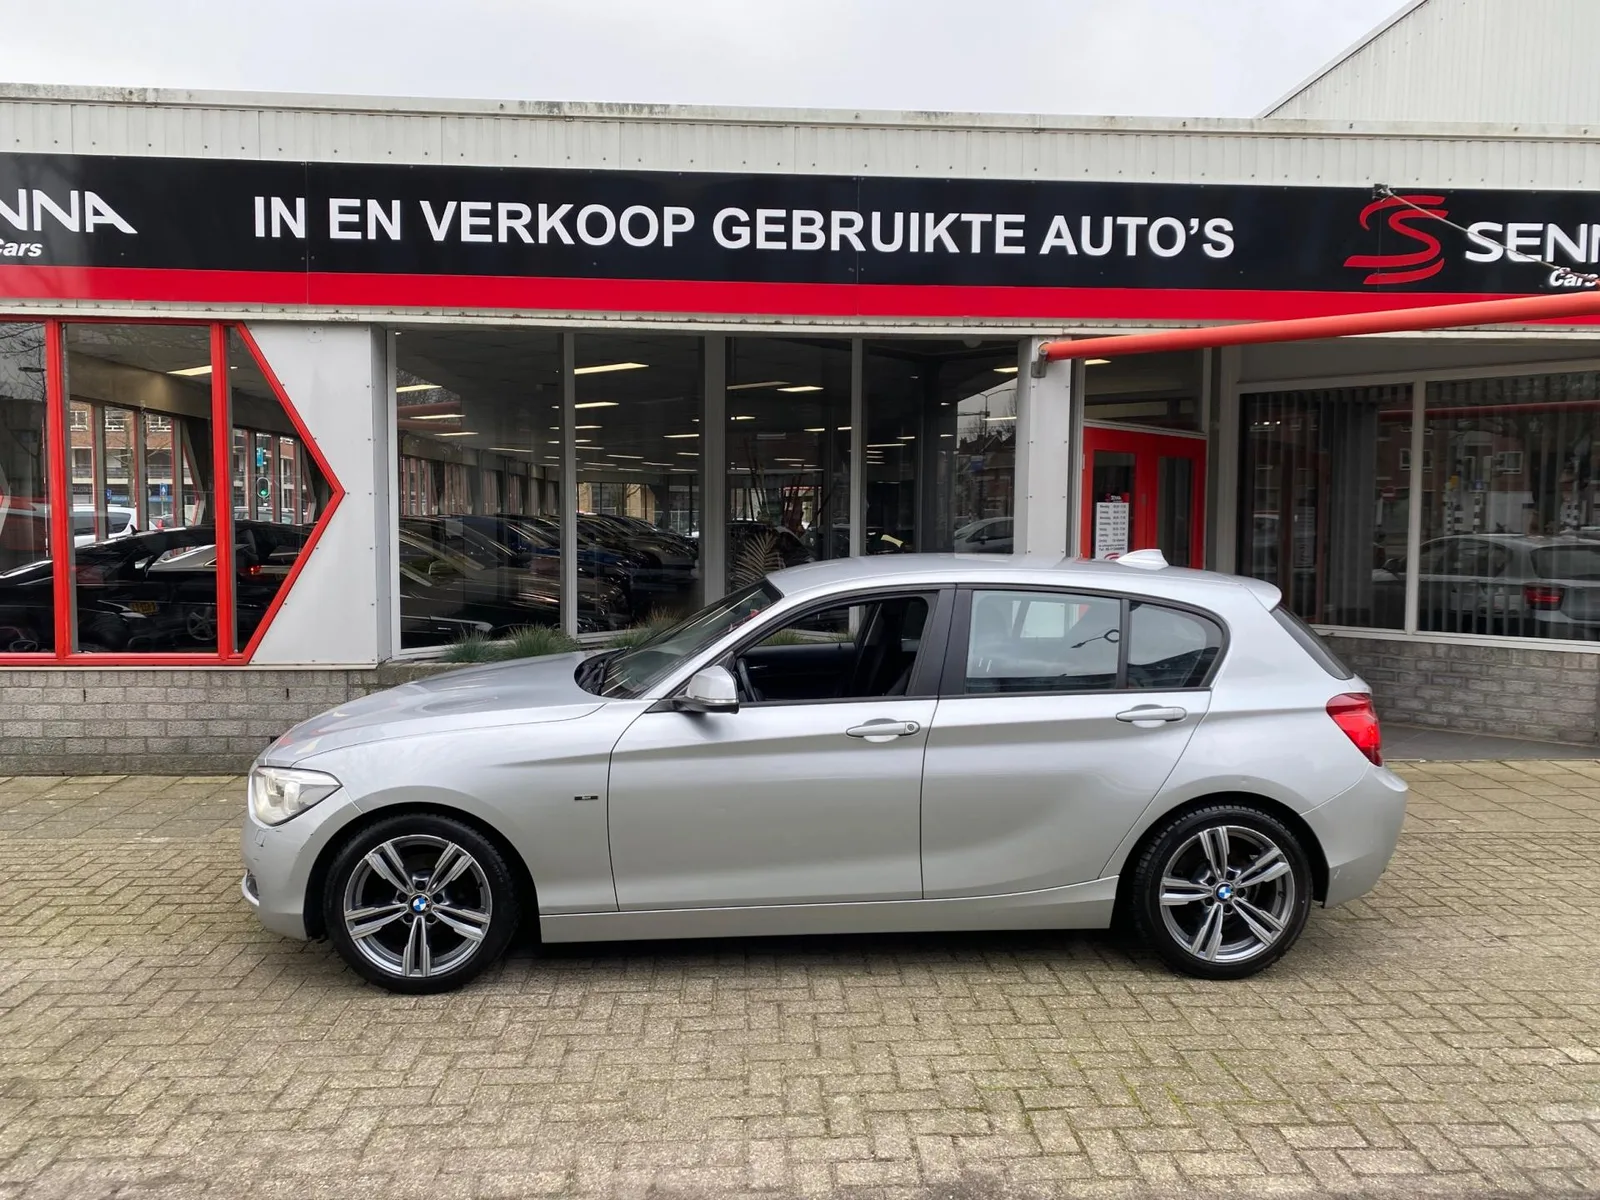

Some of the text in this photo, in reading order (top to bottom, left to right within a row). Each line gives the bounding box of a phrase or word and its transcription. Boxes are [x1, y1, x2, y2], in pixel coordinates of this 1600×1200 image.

[254, 196, 306, 239] IN
[328, 198, 401, 242] EN
[419, 200, 695, 250] VERKOOP
[712, 208, 1026, 257] GEBRUIKTE
[1464, 222, 1600, 264] SEN
